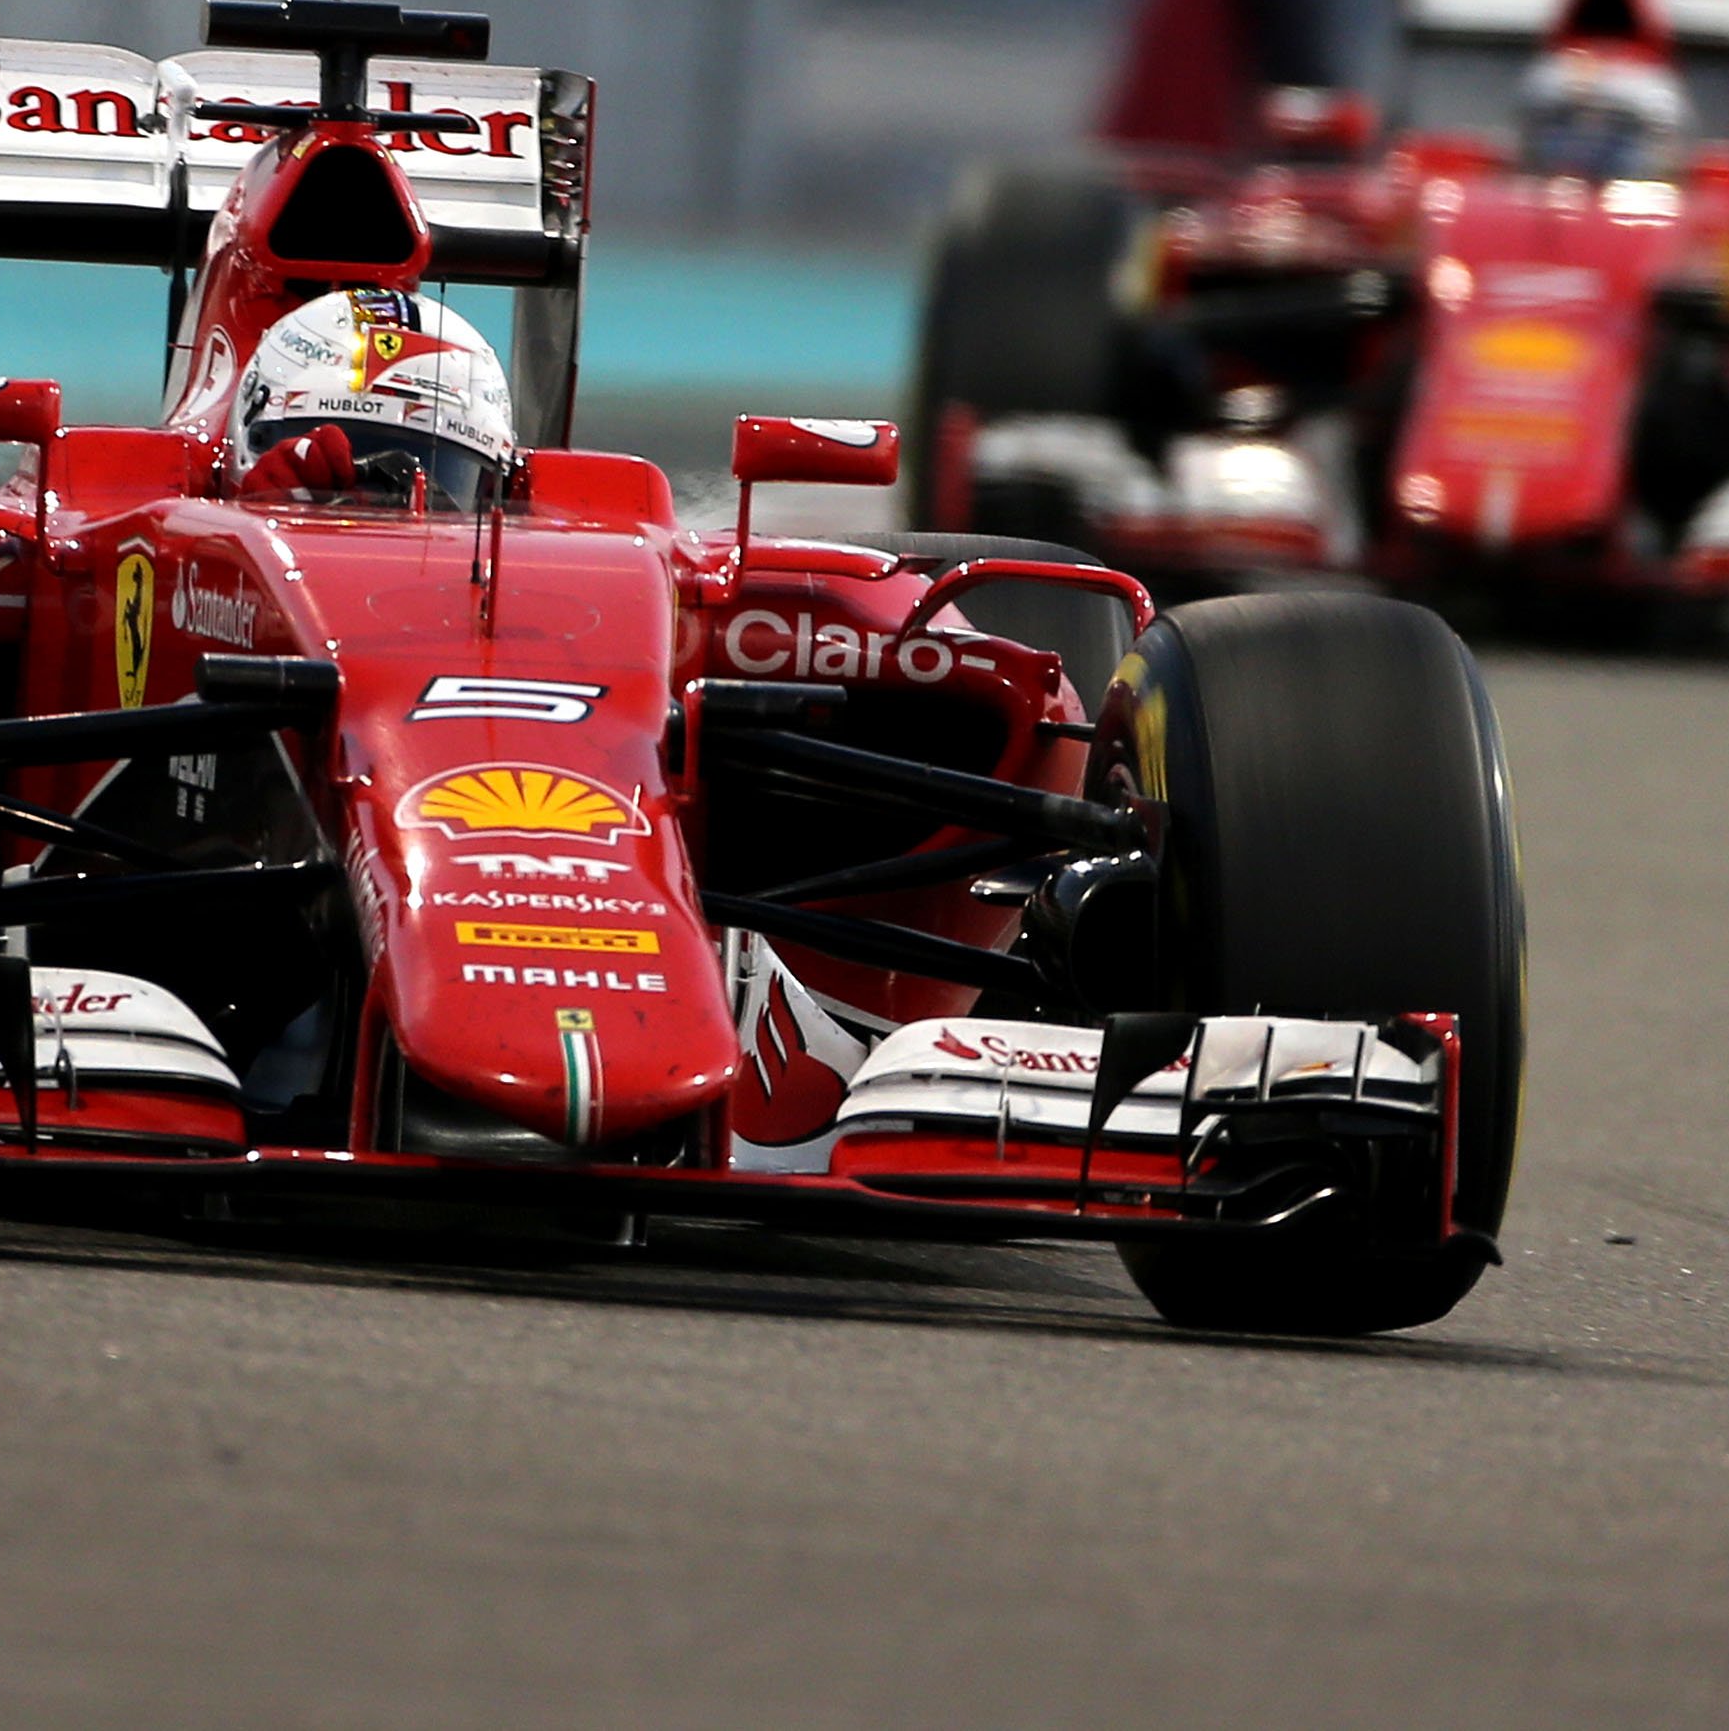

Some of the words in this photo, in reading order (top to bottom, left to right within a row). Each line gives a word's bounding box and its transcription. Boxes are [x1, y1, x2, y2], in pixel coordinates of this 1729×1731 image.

[318, 397, 385, 415] HUBLOT
[446, 418, 495, 449] HUBLOT
[186, 561, 258, 649] Santander
[725, 608, 953, 684] Claro
[409, 675, 609, 723] 5
[450, 854, 632, 877] TNT
[432, 890, 647, 914] KASPERSKY
[461, 964, 668, 993] MAHLE
